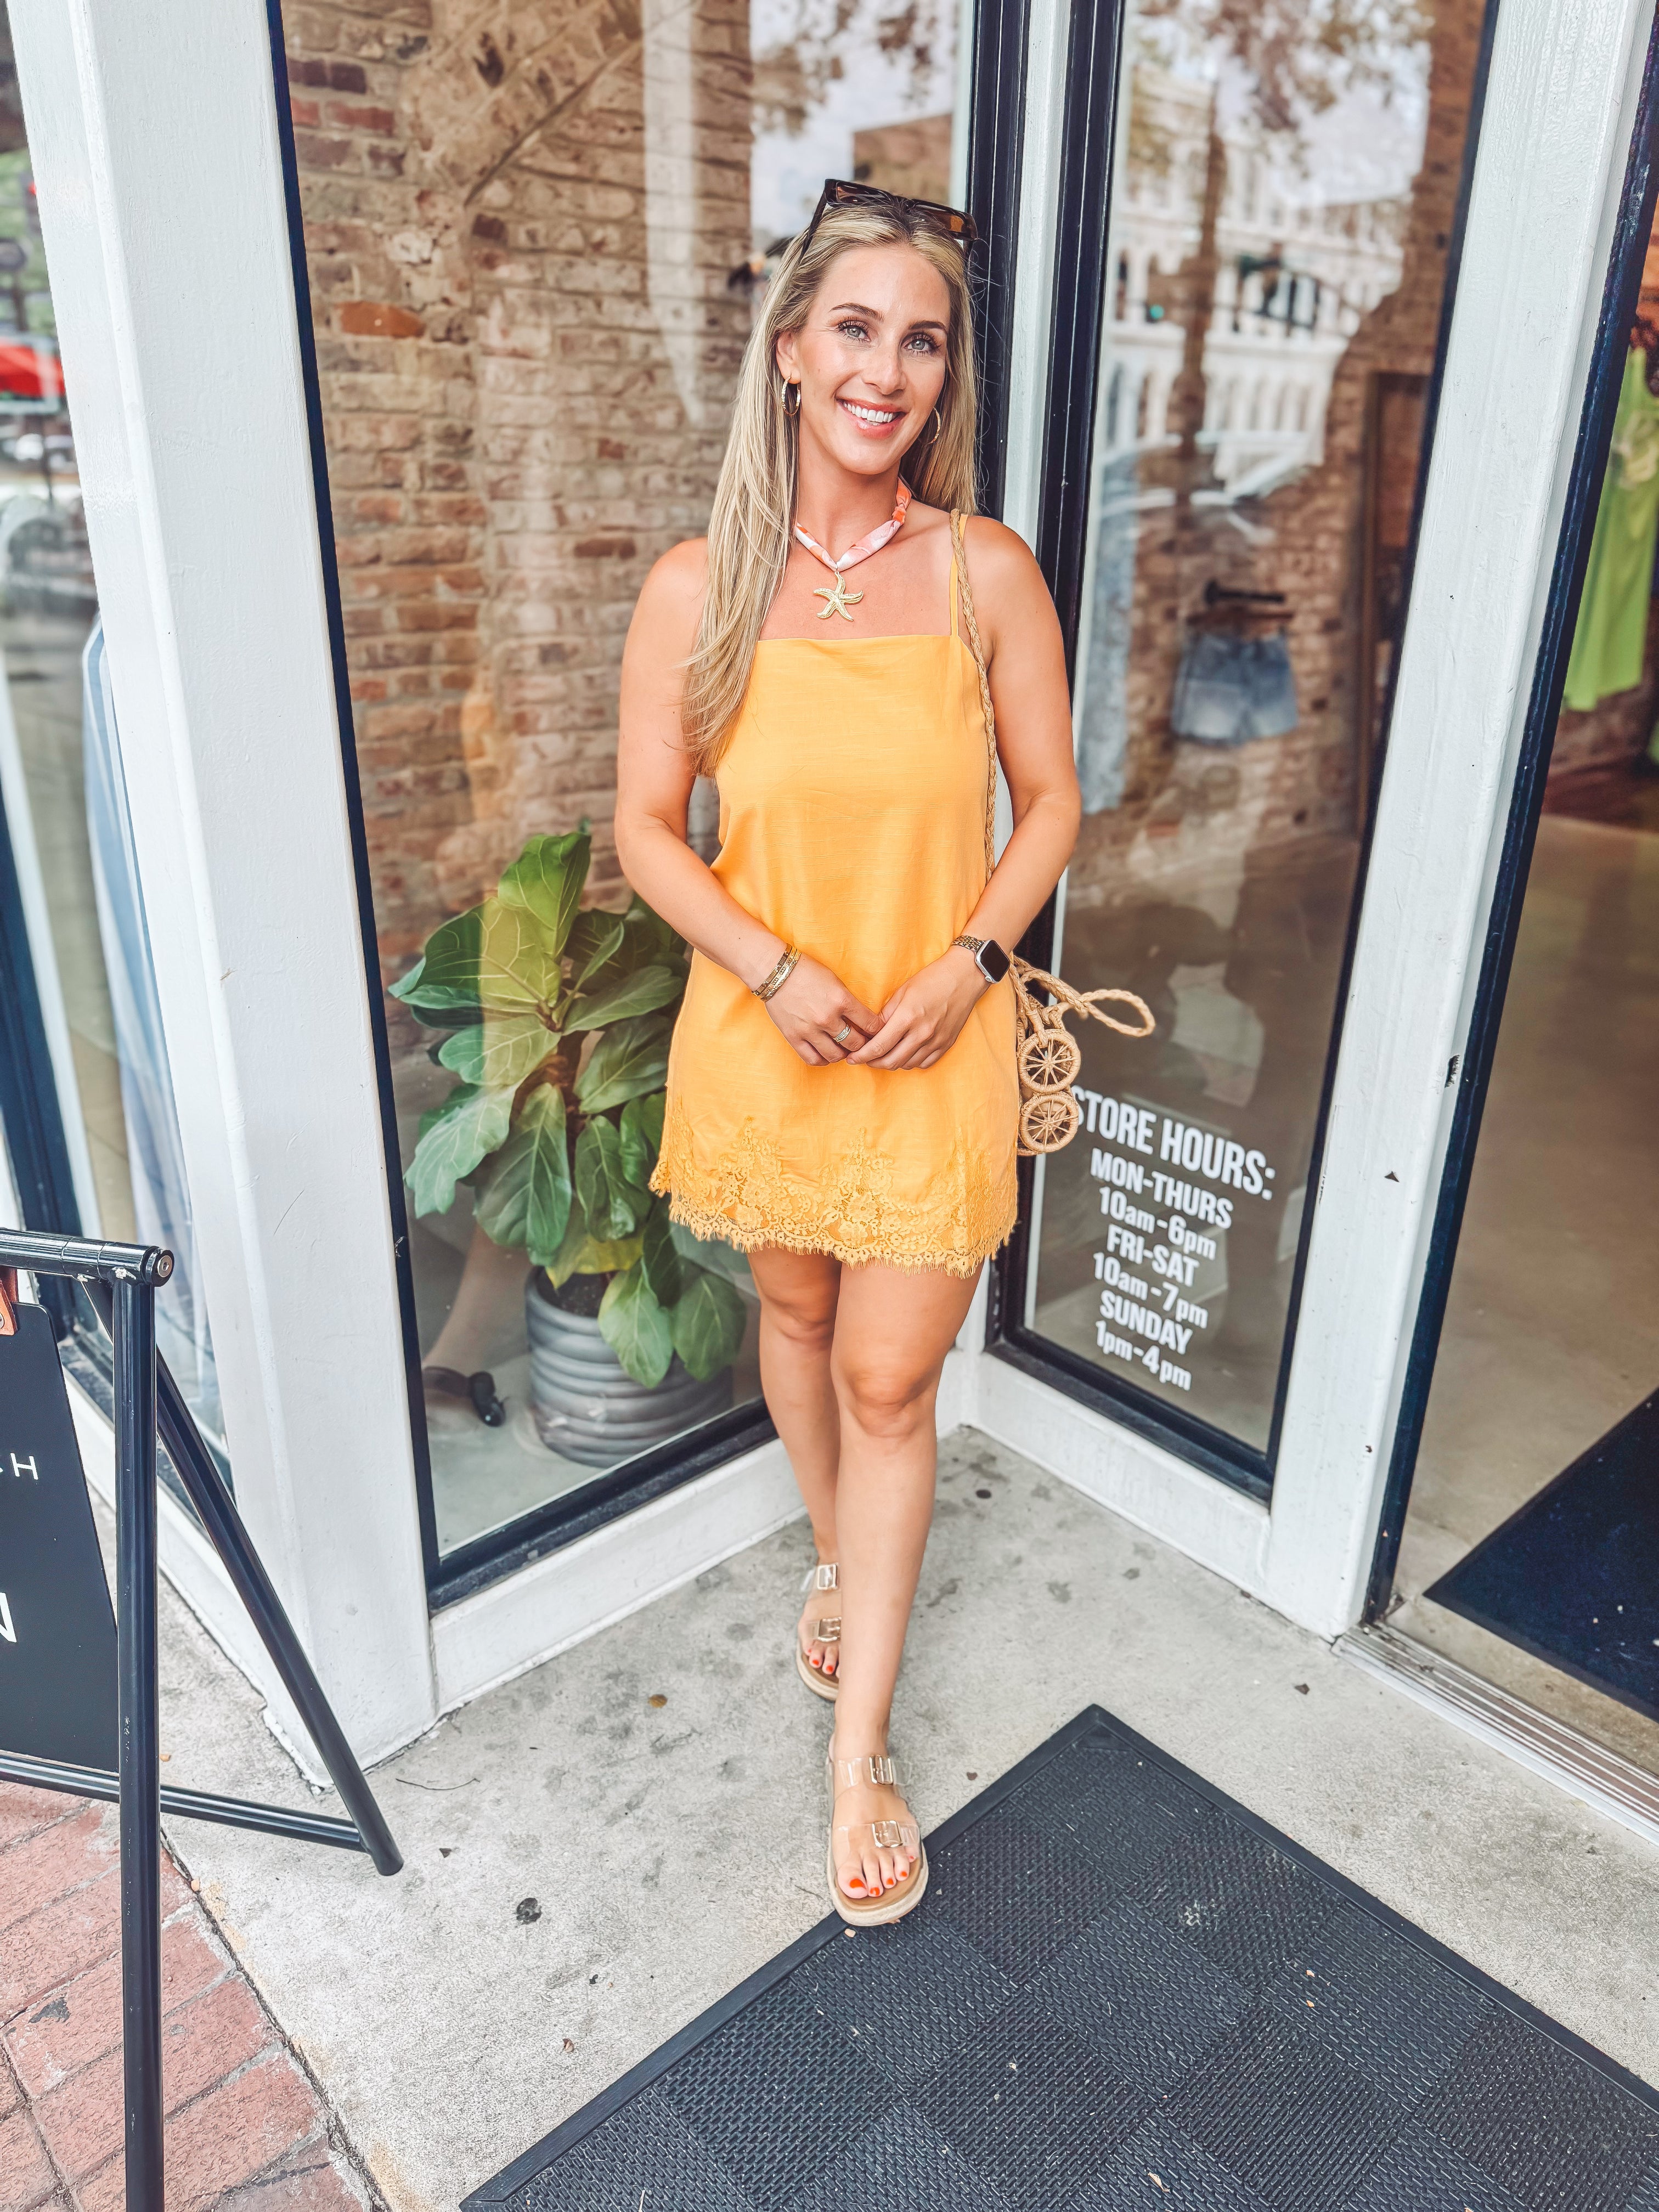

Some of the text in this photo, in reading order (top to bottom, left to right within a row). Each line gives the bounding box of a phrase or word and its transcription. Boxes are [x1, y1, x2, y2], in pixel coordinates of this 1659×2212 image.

[1090, 1147, 1234, 1229] MON-THURS
[1160, 1118, 1276, 1201] HOURS:
[1106, 1223, 1200, 1287] FRI-SAT
[1099, 1289, 1193, 1355] SUNDAY
